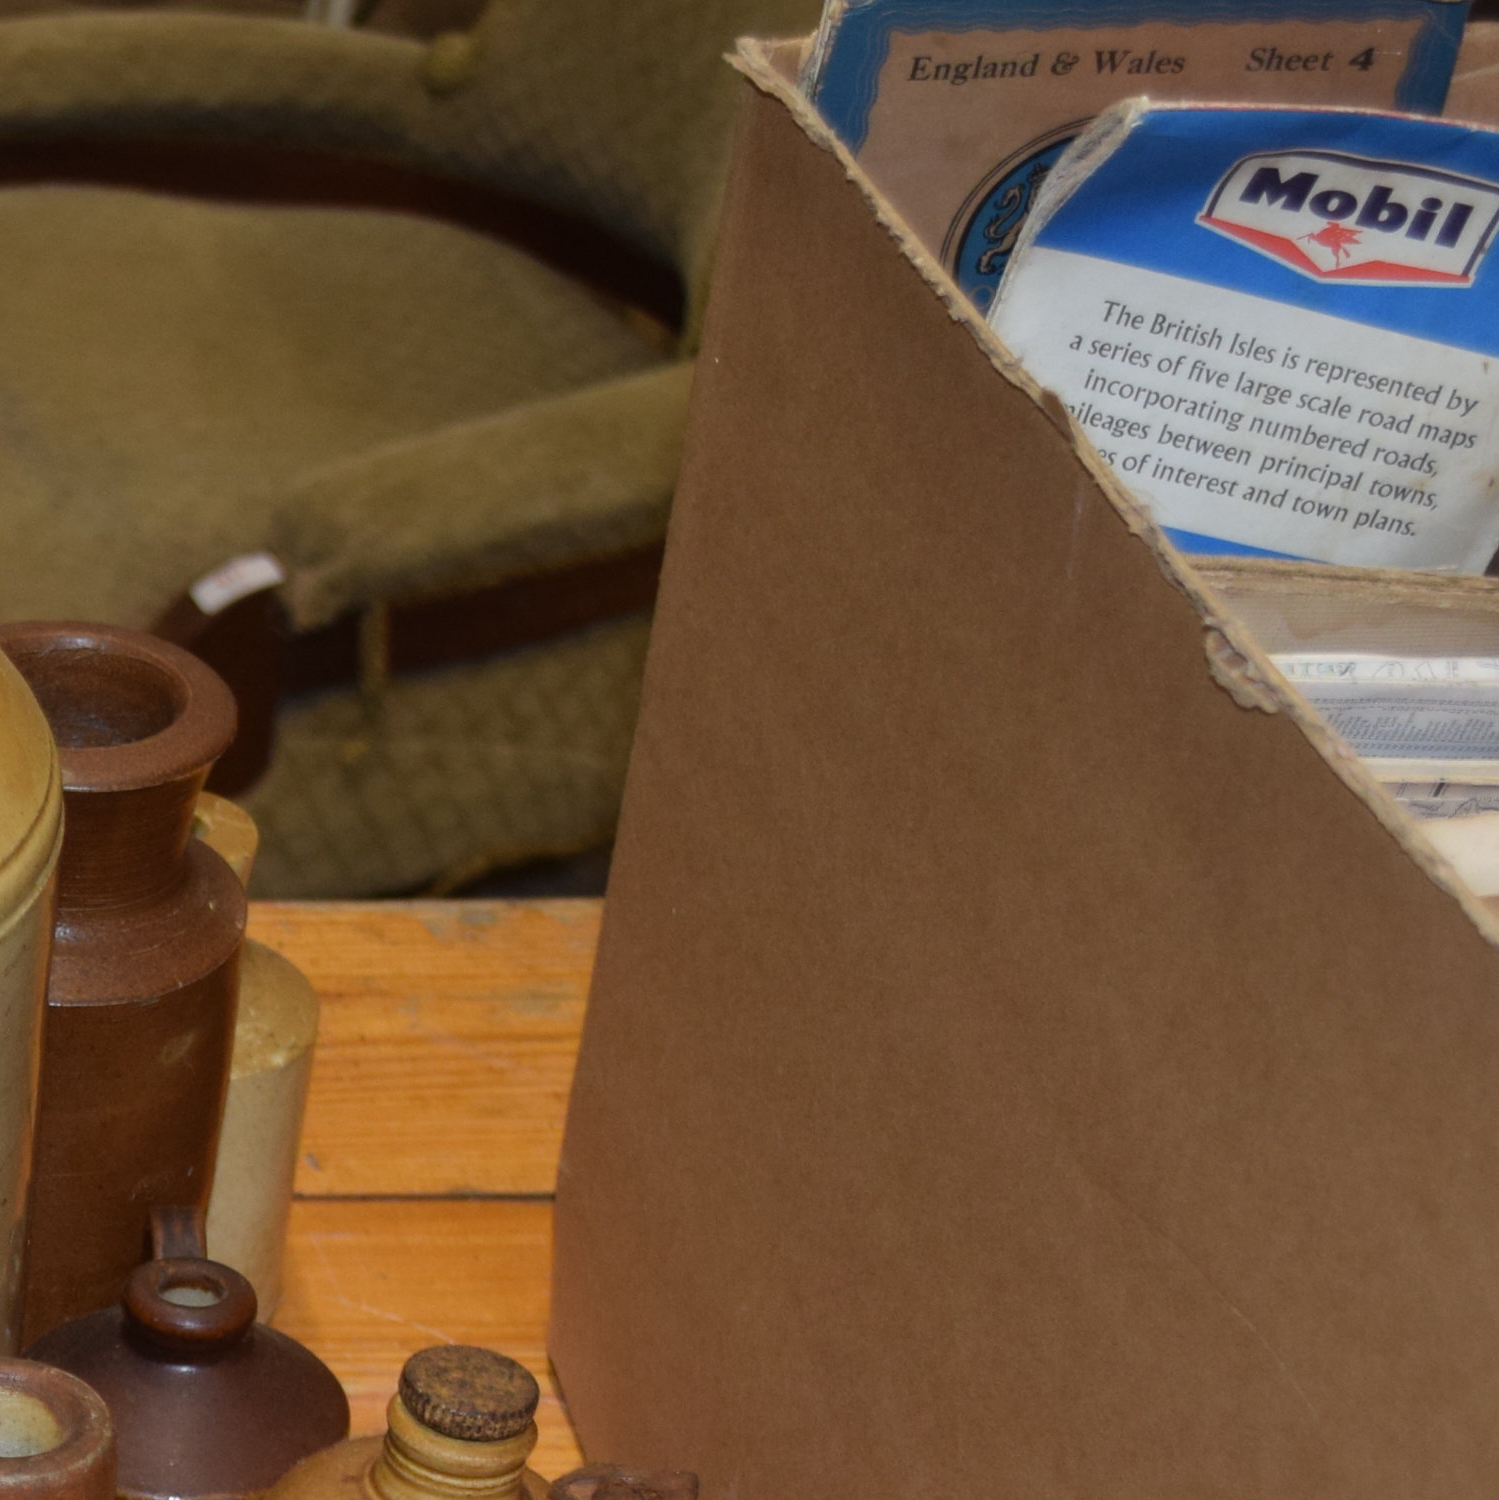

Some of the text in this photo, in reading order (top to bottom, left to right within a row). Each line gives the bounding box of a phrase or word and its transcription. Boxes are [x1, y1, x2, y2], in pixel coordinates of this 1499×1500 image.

[907, 46, 1375, 86] England & Wales Sheet 4
[1240, 167, 1474, 249] Mobil
[1069, 334, 1478, 450] a series of five large scale road maps
[1103, 300, 1480, 418] The British Isles is represented by
[1084, 368, 1439, 478] incorporating numbered roads,
[1122, 453, 1152, 475] of
[1152, 458, 1239, 499] interest
[1242, 482, 1289, 509] and
[1292, 496, 1349, 523] town
[1353, 509, 1416, 537] plans.
[1157, 424, 1252, 466] between
[1259, 453, 1364, 493] principal
[1369, 479, 1439, 511] towns,
